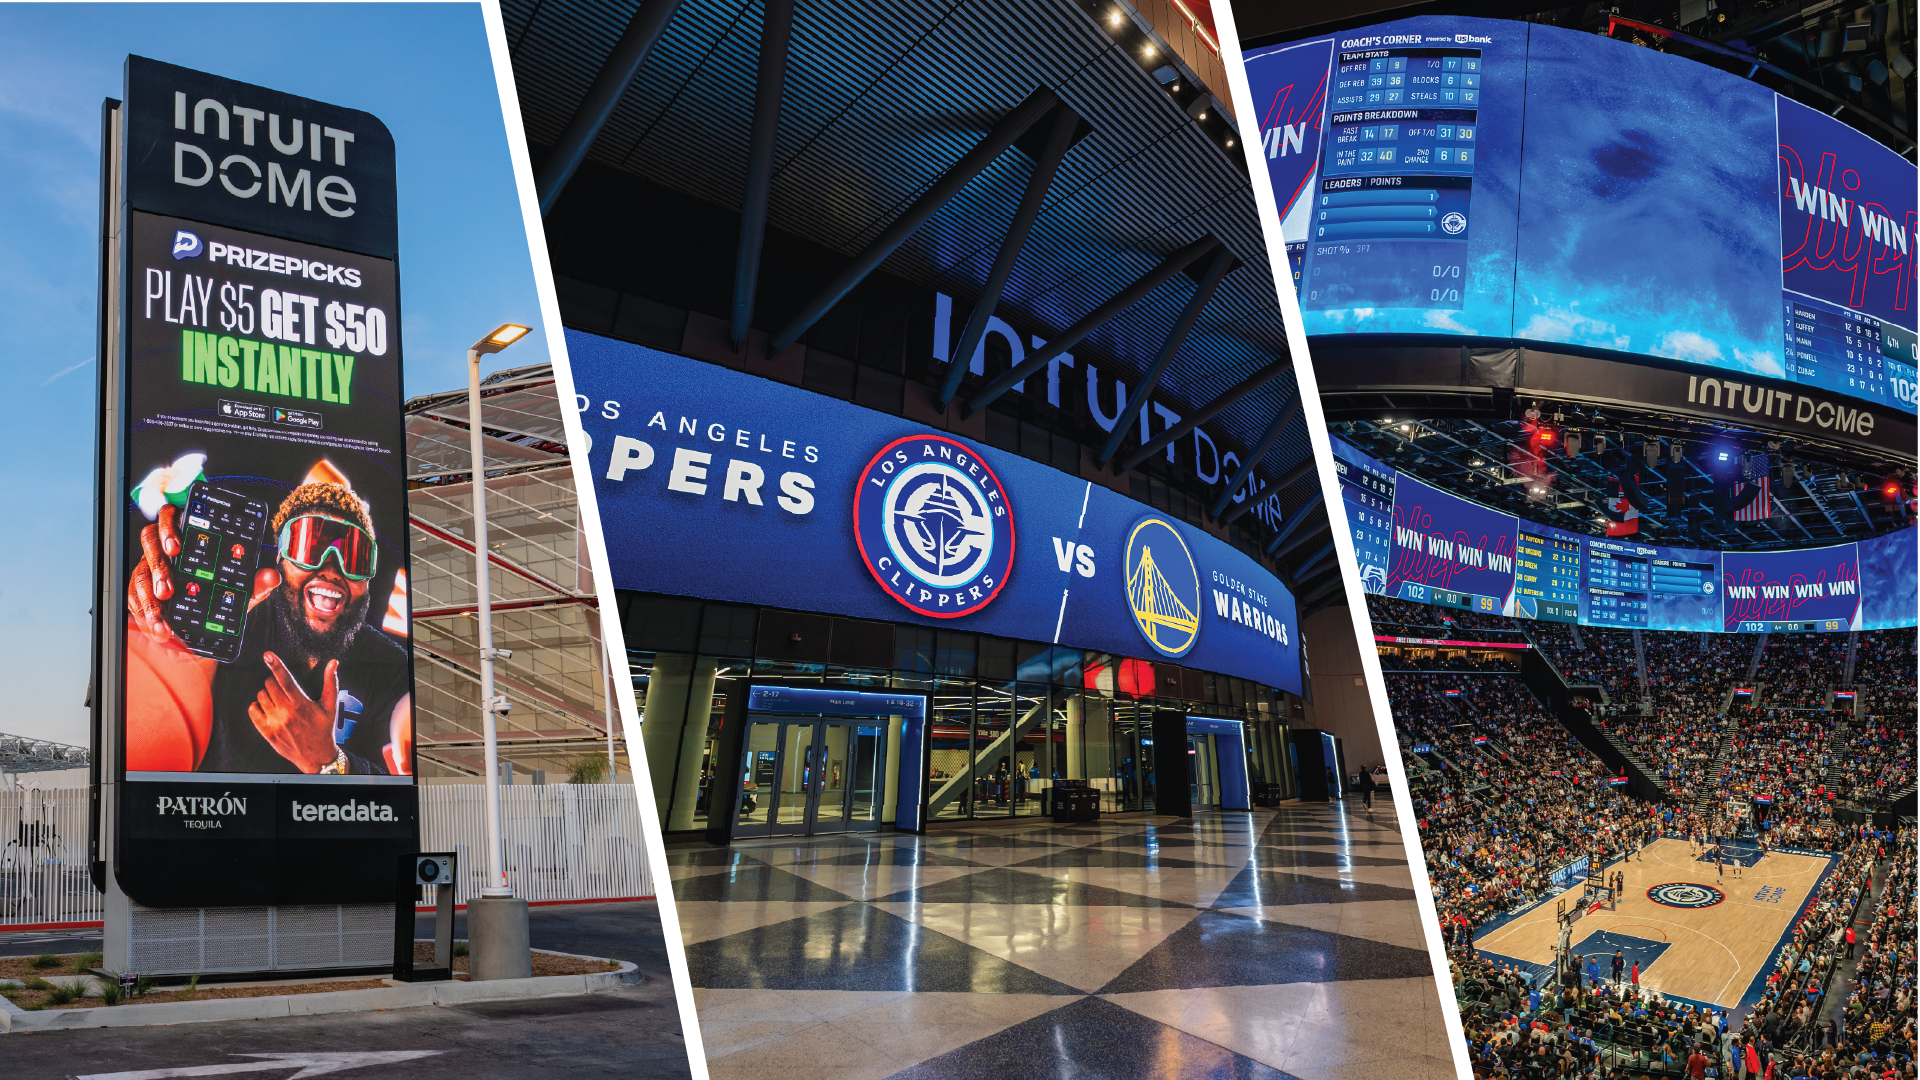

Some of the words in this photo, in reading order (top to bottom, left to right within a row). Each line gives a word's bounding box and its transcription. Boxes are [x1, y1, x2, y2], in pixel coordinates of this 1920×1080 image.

[1342, 36, 1381, 48] COACH'S
[1383, 35, 1421, 44] CORNER
[1343, 53, 1364, 61] TEAM
[1372, 78, 1382, 86] 39
[1390, 77, 1401, 85] 36
[1337, 96, 1362, 104] ASSISTS
[1370, 94, 1380, 102] 29
[1389, 93, 1399, 101] 27
[1411, 92, 1438, 100] STEALS
[1445, 92, 1454, 100] 10
[1334, 112, 1363, 123] POINTS
[1365, 110, 1418, 120] BREAKDOWN
[175, 91, 354, 166] INTUIT
[1343, 127, 1358, 135] FAST
[1365, 129, 1374, 139] 14
[1384, 129, 1394, 138] 17
[1441, 128, 1451, 138] 31
[1460, 129, 1472, 139] 30
[1338, 135, 1357, 143] BREAK
[1345, 150, 1356, 158] THE
[1361, 152, 1373, 161] 32
[1380, 151, 1392, 160] 40
[1441, 151, 1447, 160] 6
[1461, 152, 1467, 161] 6
[1338, 158, 1355, 166] PAINT
[174, 141, 356, 218] DOME
[1325, 179, 1361, 190] LEADERS
[1370, 178, 1401, 186] POINTS
[1790, 177, 1848, 227] WIN
[1858, 205, 1907, 255] WIN
[1317, 247, 1338, 255] SHOT
[209, 242, 362, 288] PRIZEPICKS
[1433, 265, 1459, 278] 0/0
[1431, 288, 1458, 302] 0/0
[146, 268, 214, 326] PLAY
[220, 280, 254, 334] $5
[260, 288, 319, 346] GET
[324, 300, 387, 356] $50
[1795, 309, 1815, 320] HARDEN
[1845, 323, 1851, 331] 12
[1856, 326, 1860, 334] 6
[1865, 329, 1871, 337] 16
[1875, 332, 1879, 340] 2
[1796, 323, 1814, 333] COFFEY
[1785, 333, 1792, 342] 14
[1796, 336, 1812, 347] MANN
[1887, 336, 1899, 349] 4TH
[1786, 348, 1794, 356] 24
[1797, 352, 1817, 362] POWELL
[182, 329, 354, 405] INSTANTLY
[1786, 363, 1794, 371] 40
[1798, 366, 1815, 377] ZUBAC
[1890, 378, 1918, 405] 102
[1688, 376, 1792, 419] INTUIT
[1796, 396, 1874, 436] DOME
[234, 409, 248, 417] App
[288, 416, 307, 424] Google
[308, 418, 319, 426] Play
[648, 411, 819, 464] ANGELES
[871, 450, 908, 488] LOS
[923, 444, 1005, 517] ANGELES
[1397, 525, 1422, 552] WIN
[1428, 536, 1453, 560] WIN
[1459, 544, 1482, 567] WIN
[1488, 552, 1511, 574] WIN
[1052, 537, 1096, 578] VS
[878, 556, 994, 606] CLIPPERS
[1213, 571, 1246, 595] GOLDEN
[1248, 587, 1268, 608] STATE
[1728, 586, 1756, 598] WIN
[1762, 586, 1789, 598] WIN
[1795, 583, 1823, 598] WIN
[1828, 580, 1855, 596] WIN
[1408, 584, 1424, 600] 102
[1447, 594, 1457, 604] 0.0
[1481, 598, 1492, 610] 99
[1213, 589, 1288, 646] WARRIORS
[1573, 609, 1577, 618] 4
[1745, 623, 1764, 631] 102
[1826, 621, 1838, 630] 99
[156, 792, 247, 816] PATRÓN
[184, 820, 222, 829] TEQUILA
